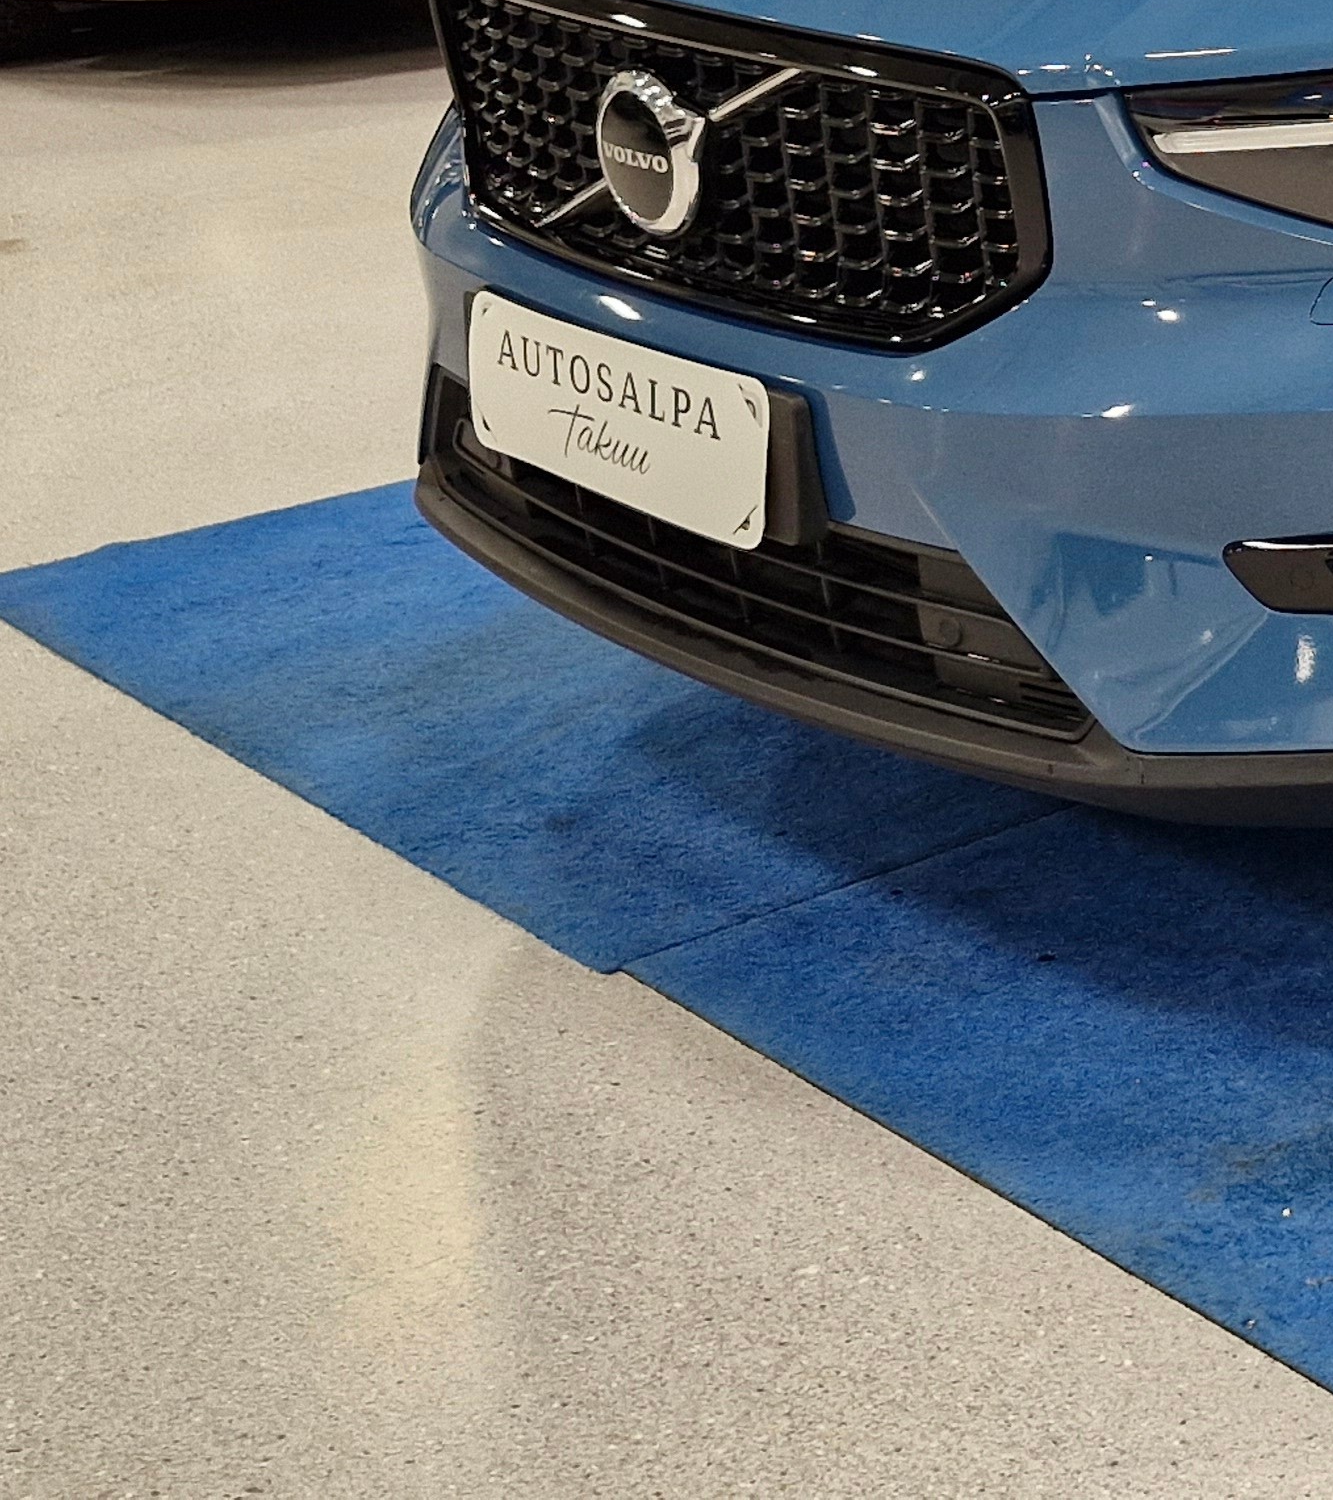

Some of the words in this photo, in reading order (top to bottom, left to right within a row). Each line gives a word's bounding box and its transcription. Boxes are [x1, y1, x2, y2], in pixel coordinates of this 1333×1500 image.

[603, 141, 669, 174] VOLVO
[497, 330, 721, 441] AUTOSALPA
[548, 404, 650, 474] Takuu
